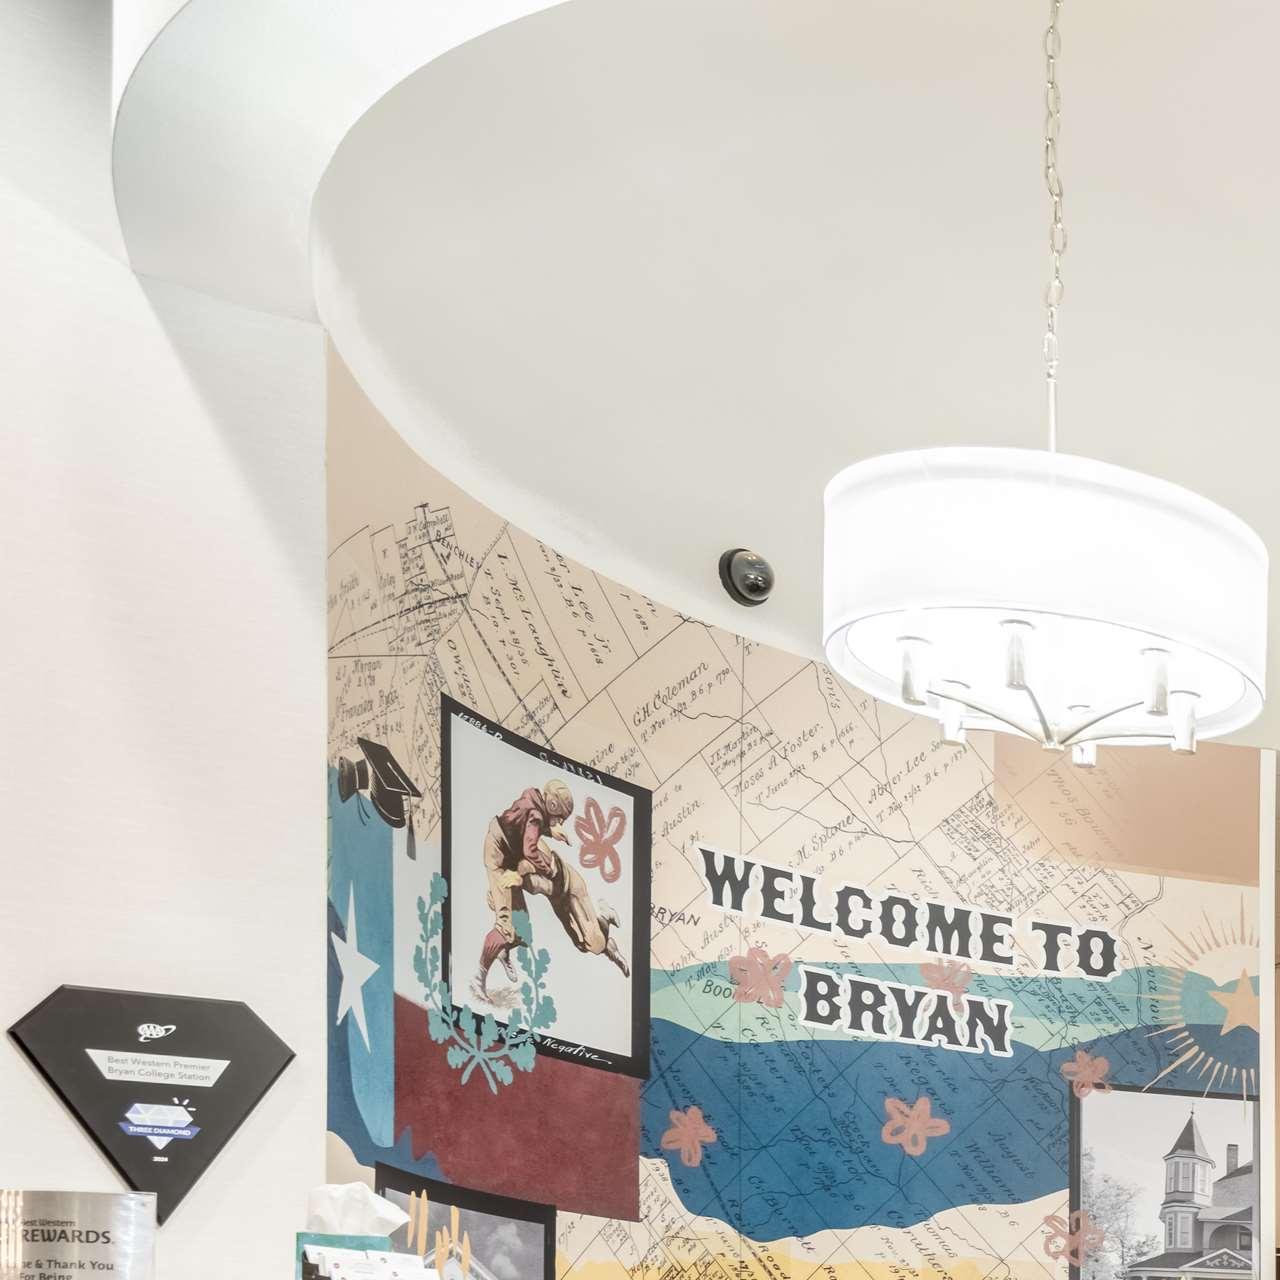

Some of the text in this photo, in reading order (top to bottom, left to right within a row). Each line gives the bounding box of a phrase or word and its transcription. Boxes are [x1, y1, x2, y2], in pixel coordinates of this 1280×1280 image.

[906, 750, 928, 773] Lee
[697, 846, 1014, 966] WELCOME
[1030, 920, 1118, 978] TO
[802, 968, 1011, 1053] BRYAN
[542, 1037, 613, 1065] Negative
[107, 1056, 211, 1071] Best Western Premier
[107, 1066, 211, 1082] Bryan College Station
[128, 1126, 192, 1137] THREE DIAMOND
[38, 1218, 76, 1228] Western
[35, 1260, 43, 1269] &
[47, 1259, 86, 1270] Thank
[90, 1261, 115, 1271] You
